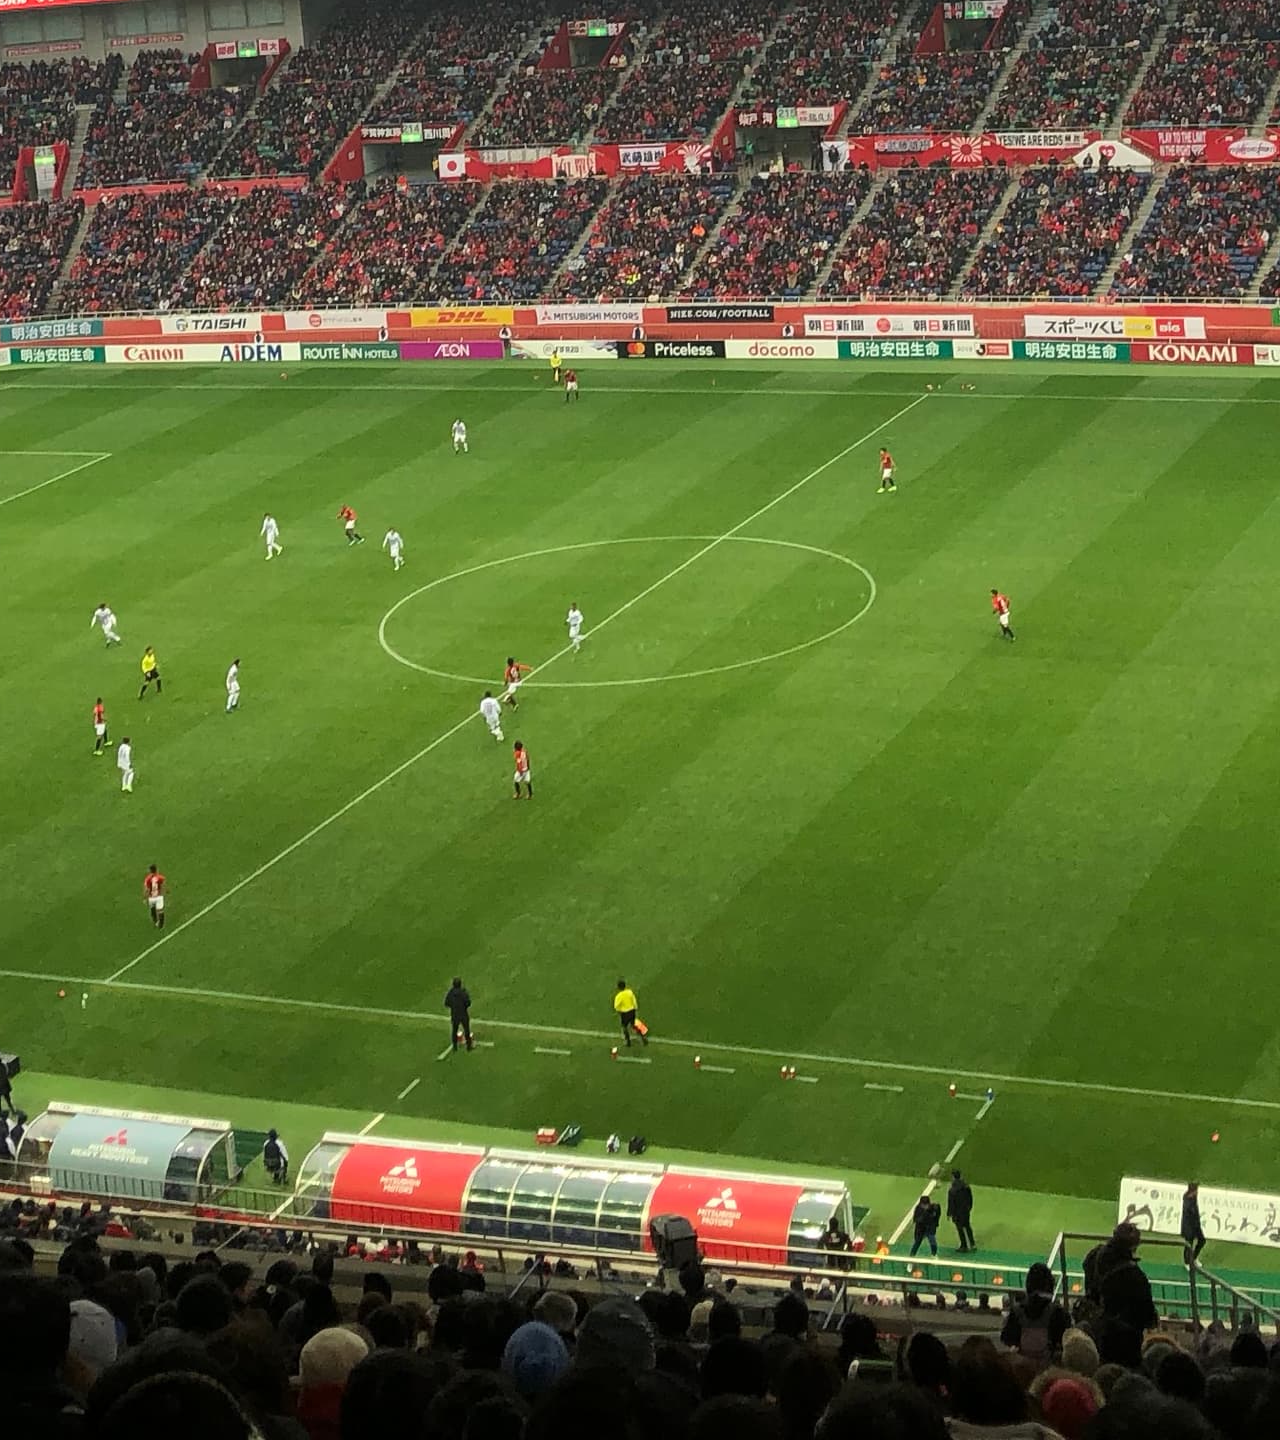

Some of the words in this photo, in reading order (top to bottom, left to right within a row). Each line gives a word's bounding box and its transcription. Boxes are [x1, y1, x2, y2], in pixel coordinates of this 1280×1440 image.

[1028, 135, 1044, 146] ARE
[1045, 134, 1064, 146] REDS
[437, 310, 489, 323] DHL
[553, 312, 601, 321] MITSUBISHI
[603, 311, 639, 321] MOTORS
[669, 307, 770, 320] NIKE.COM/FOOTBALL
[11, 320, 94, 341] 明治安田生命
[192, 318, 248, 331] TAISHI
[808, 319, 864, 332] 朝日新聞
[913, 319, 971, 332] 朝日新聞
[1044, 320, 1124, 334] スポーツくじ
[19, 347, 95, 362] 明治安田生命
[124, 345, 184, 361] Canon
[303, 346, 339, 360] ROUTE
[365, 348, 398, 359] HOTELS
[749, 343, 815, 356] docomo
[850, 341, 940, 358] 明治安田生命
[1025, 342, 1117, 359] 明治安田生命
[1148, 344, 1238, 362] KONAMI
[379, 1175, 421, 1187] MITSUBISHI
[383, 1184, 414, 1195] MOTORS
[1202, 1196, 1260, 1212] TAKASAGO
[696, 1208, 742, 1220] MITSUBISHI
[700, 1217, 734, 1228] MOTORS
